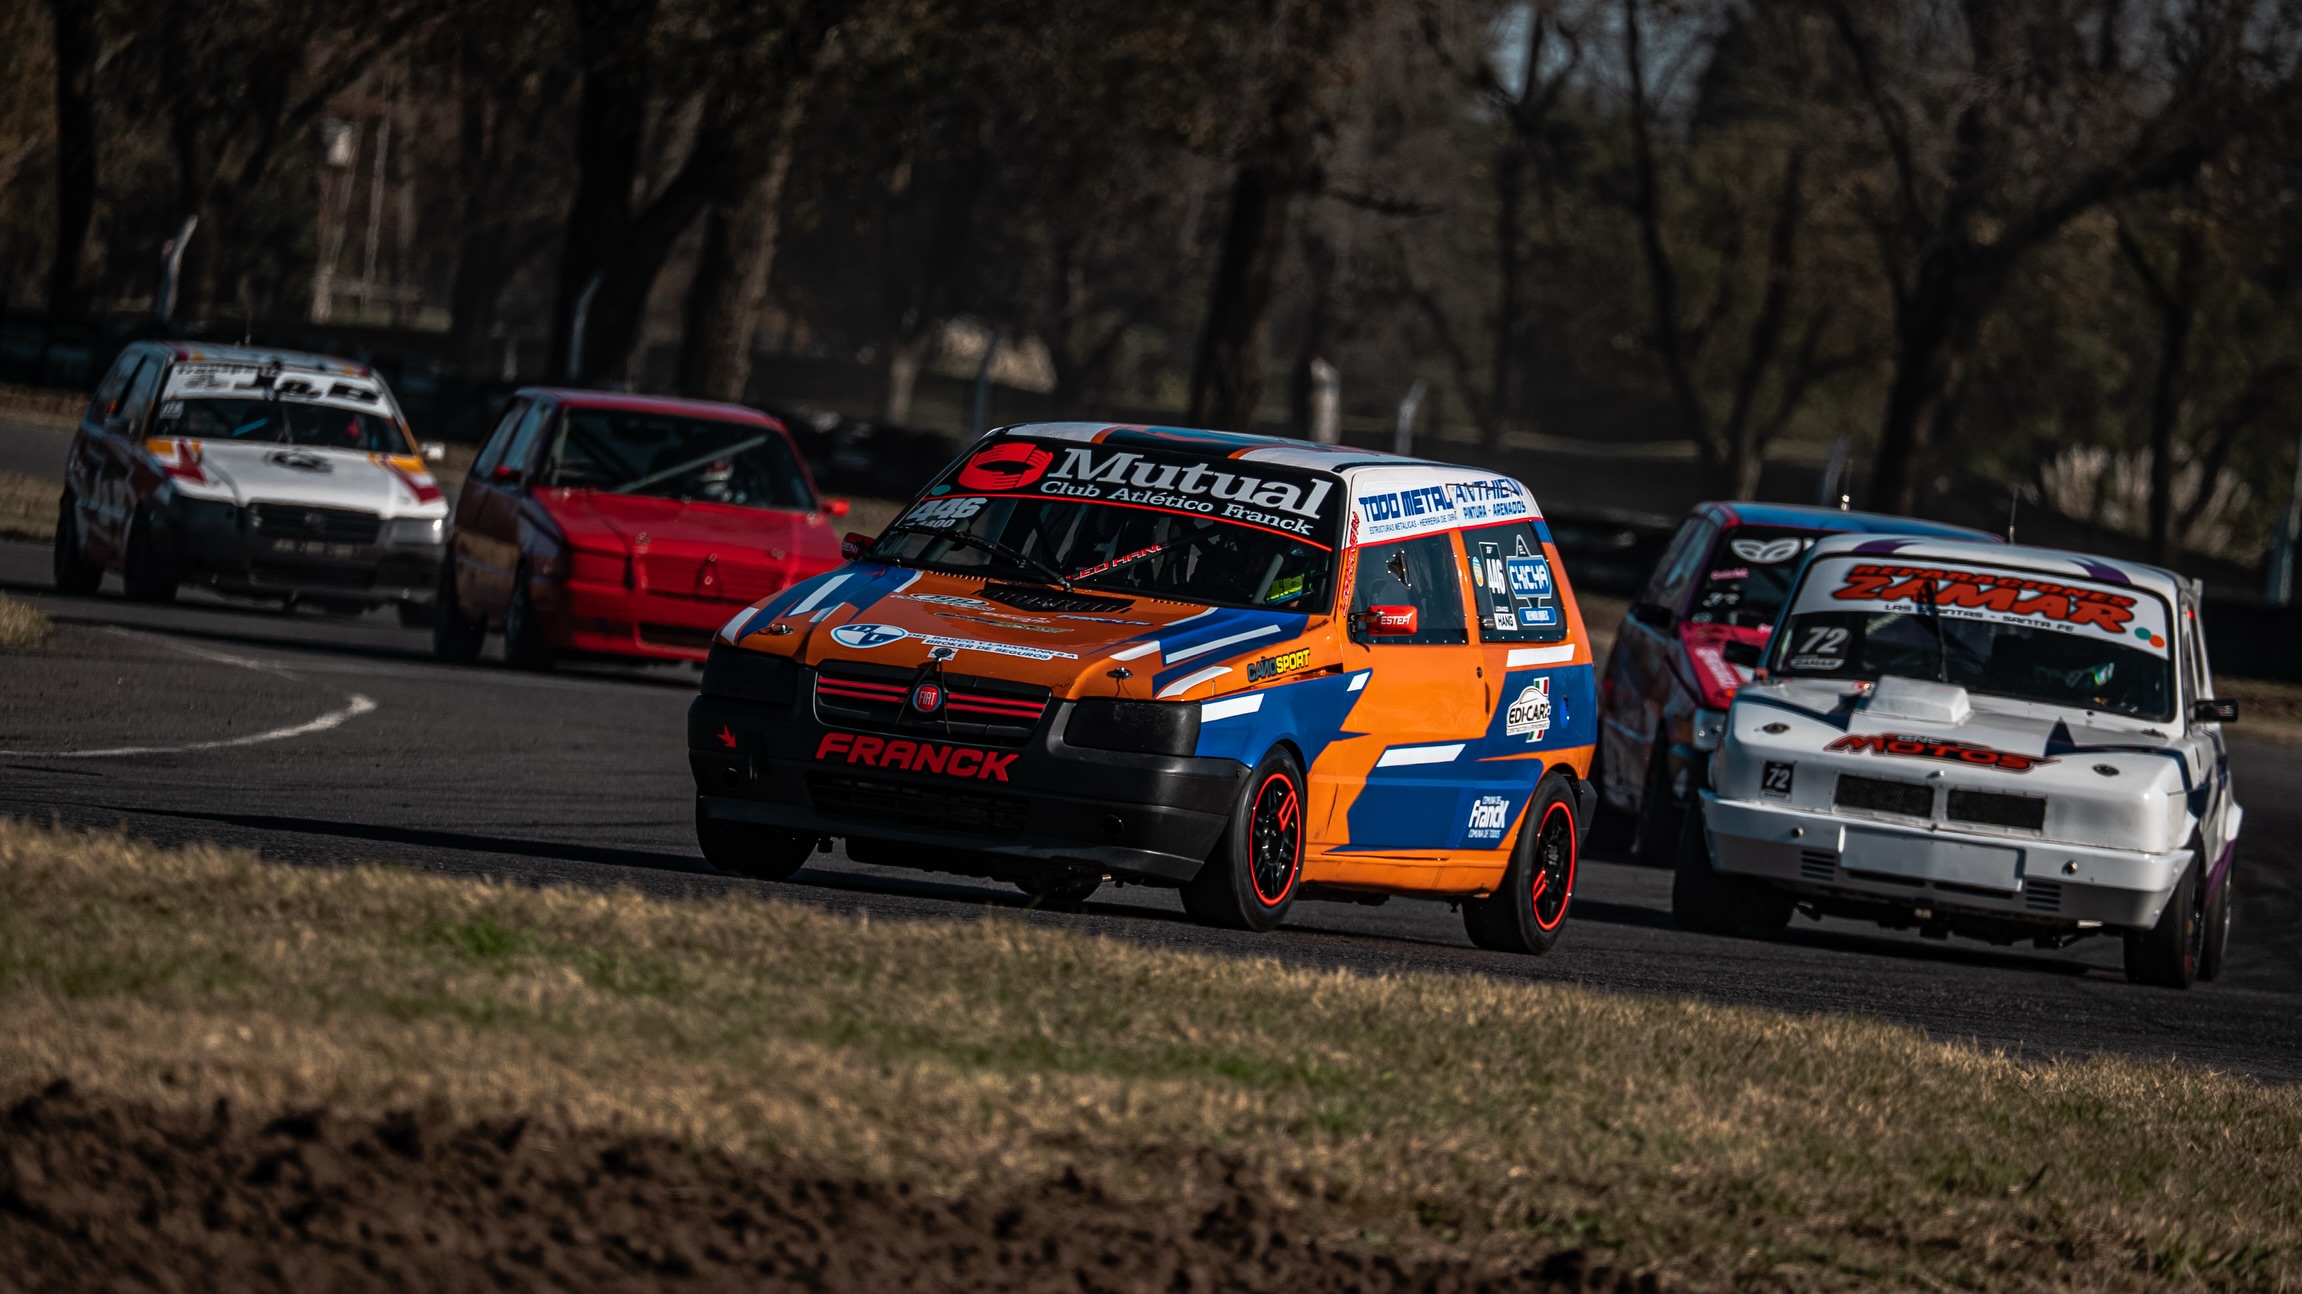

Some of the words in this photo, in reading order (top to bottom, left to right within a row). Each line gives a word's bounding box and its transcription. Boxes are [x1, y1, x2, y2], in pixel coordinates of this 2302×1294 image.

[1047, 448, 1333, 520] Mutual
[906, 497, 988, 522] 446
[1041, 481, 1100, 498] Club
[1107, 487, 1214, 513] Atlético
[1220, 503, 1315, 536] Franck
[1358, 492, 1401, 522] TODO
[1401, 485, 1455, 517] METAL
[1463, 505, 1487, 519] PINTURA
[1493, 500, 1527, 517] ARENADOS
[1486, 558, 1506, 594] 446
[1509, 565, 1549, 590] CHICHA
[1850, 565, 2138, 607] REPARACIONES
[1380, 611, 1414, 625] ESTEFI
[1830, 575, 2135, 634] ZAMAR
[1885, 604, 1912, 612] LAS
[2002, 615, 2052, 628] SANTA
[2056, 624, 2075, 632] FE
[1497, 614, 1514, 627] HANG
[925, 639, 973, 649] BROKER
[994, 648, 1050, 659] SEGUROS
[1799, 626, 1849, 654] 72
[919, 691, 937, 706] FIAT
[815, 732, 1020, 782] FRANCK
[1832, 735, 2035, 770] MOTOS
[1765, 767, 1790, 790] 72
